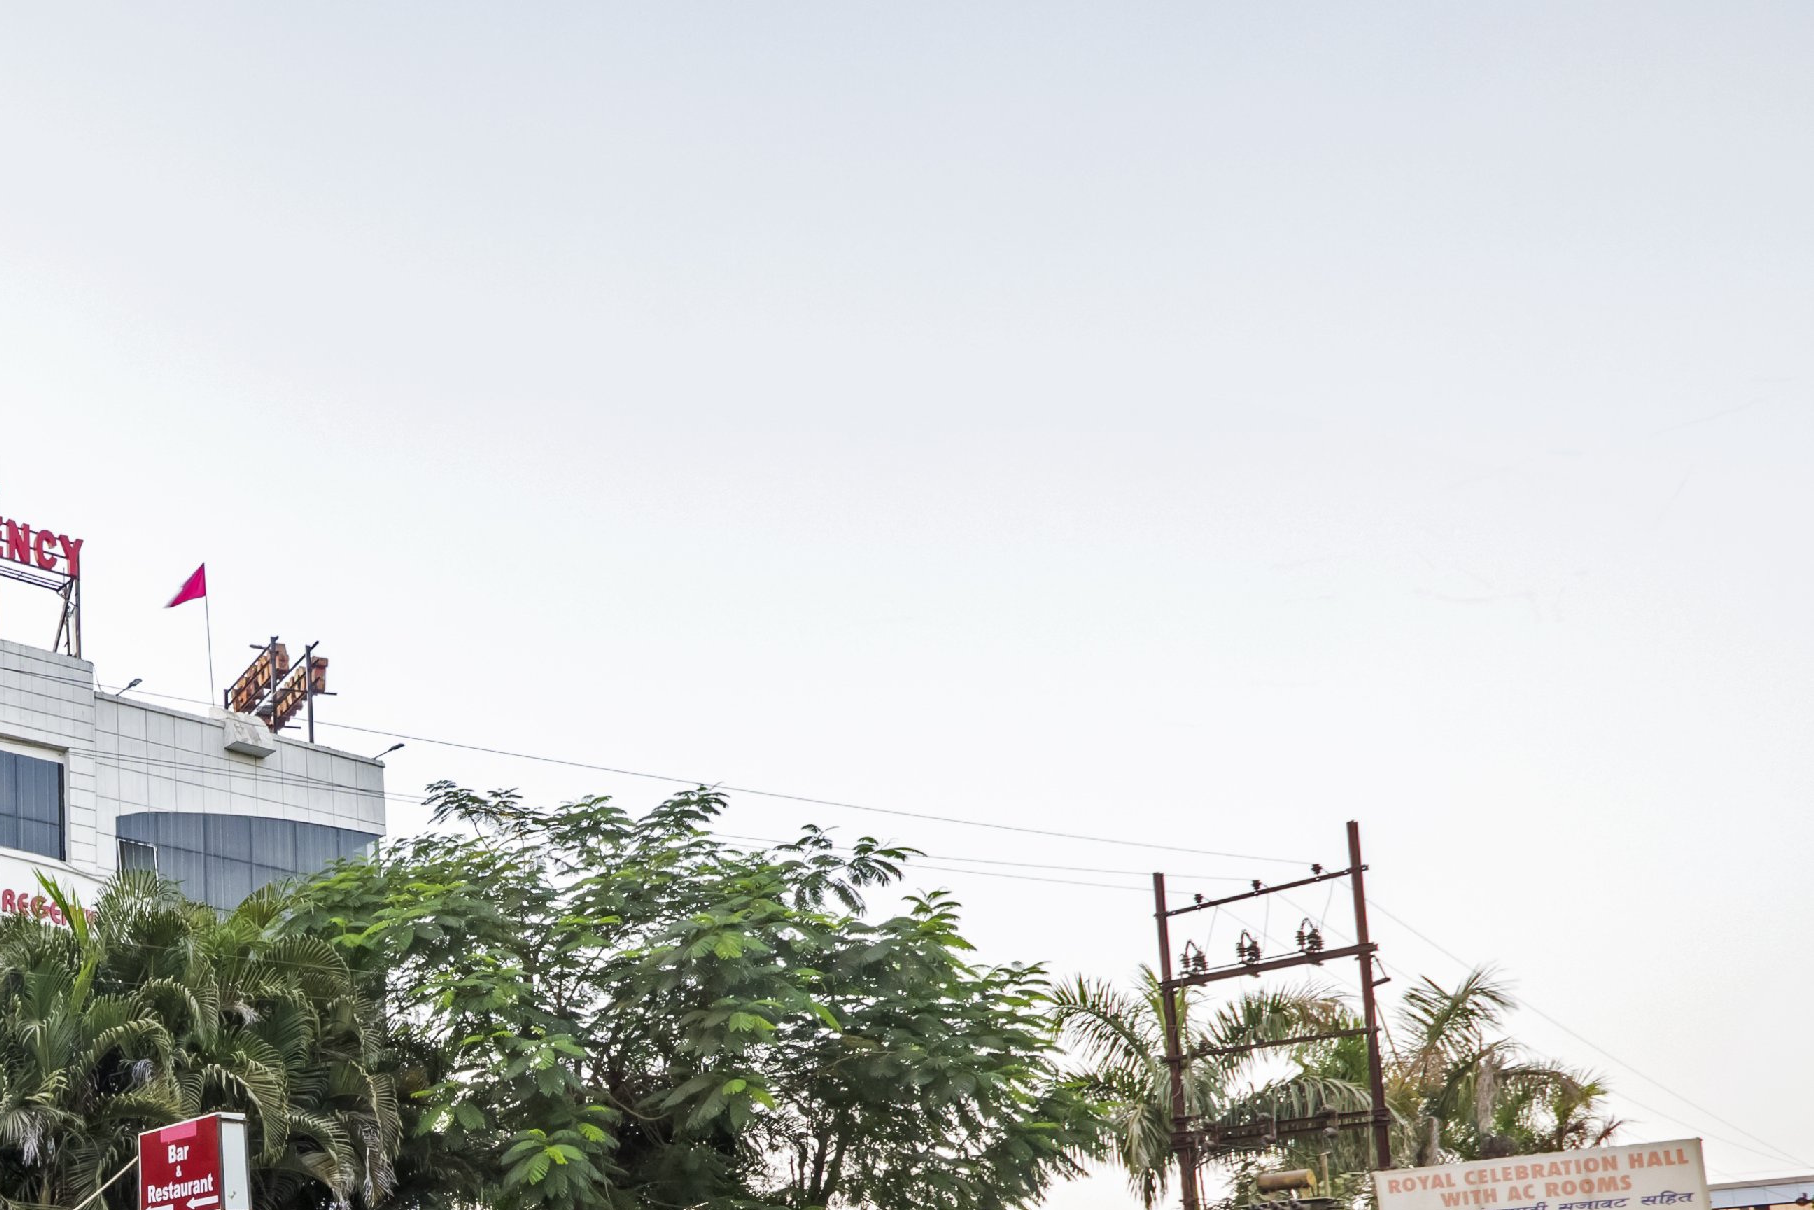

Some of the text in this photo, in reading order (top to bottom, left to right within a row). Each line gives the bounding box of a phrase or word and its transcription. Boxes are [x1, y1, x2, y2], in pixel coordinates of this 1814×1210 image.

[167, 1144, 189, 1164] Bar
[175, 1165, 182, 1177] &
[1387, 1148, 1689, 1194] ROYAL CELEBRATION HALL
[147, 1173, 214, 1204] Restaurant
[1440, 1175, 1632, 1208] WITH AC ROOMS
[1641, 1190, 1695, 1206] सहित
